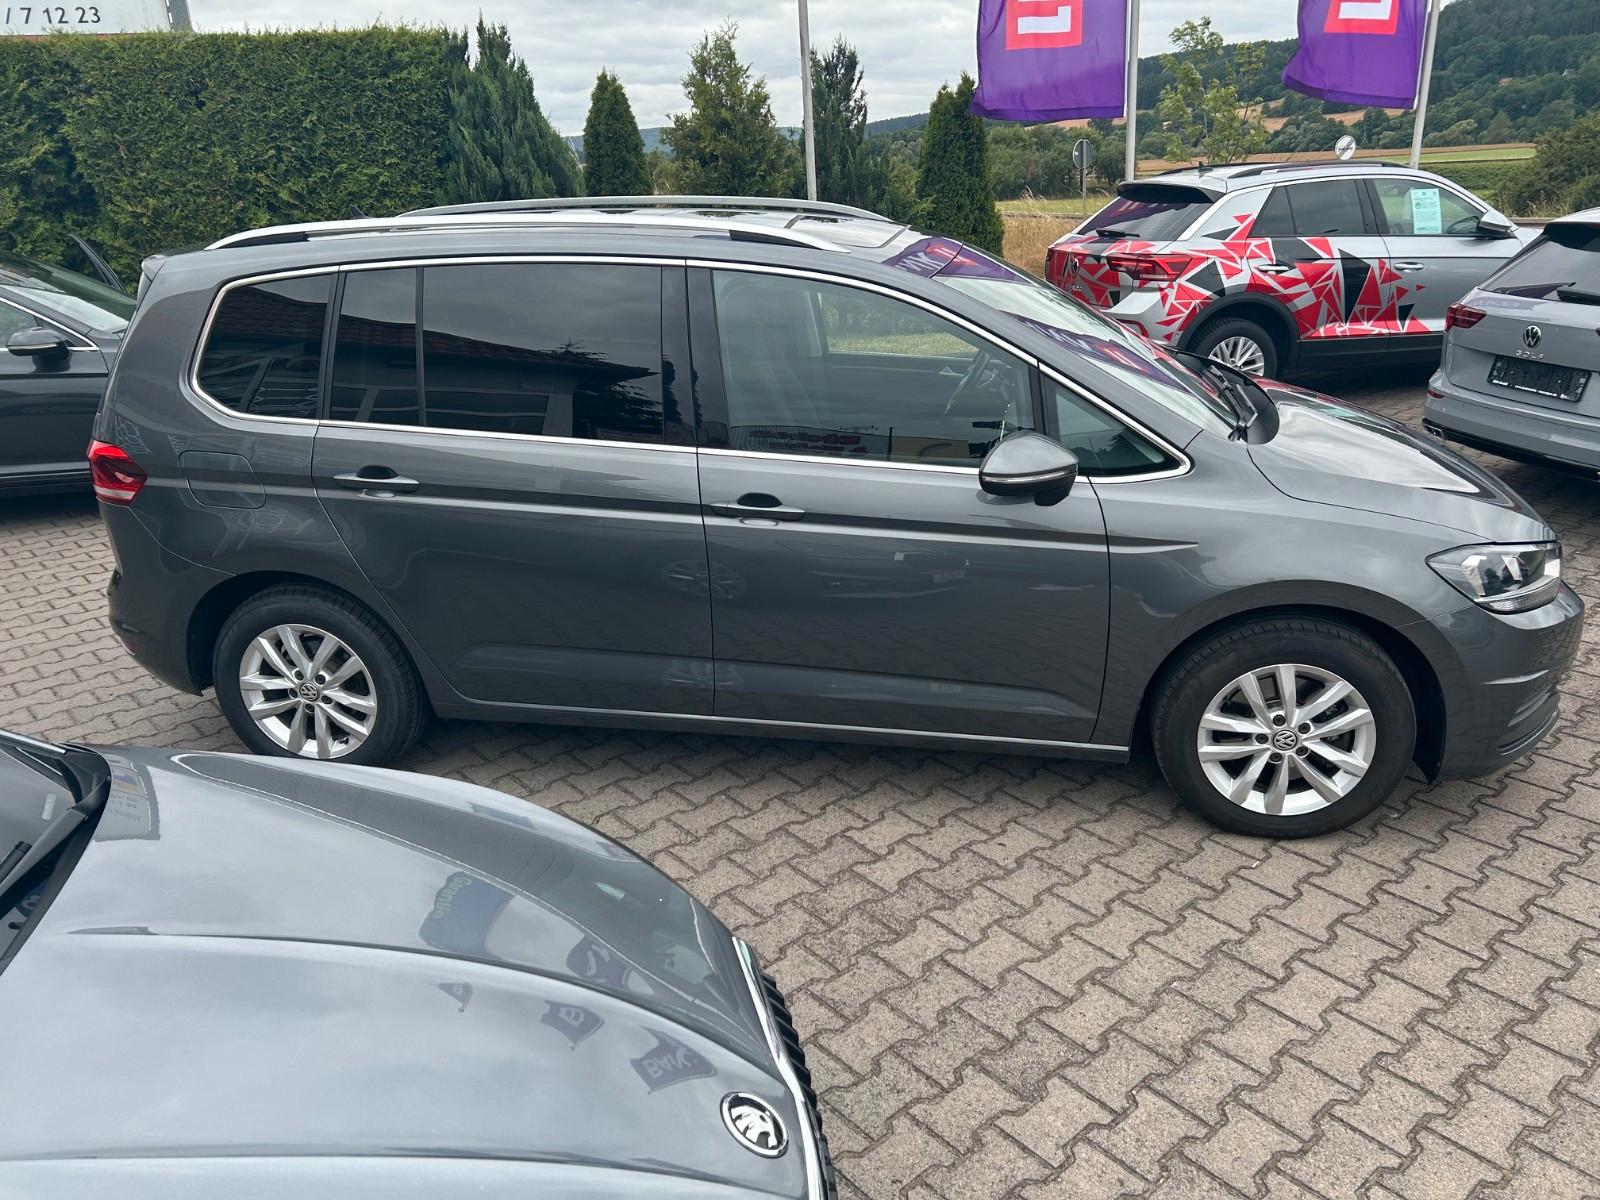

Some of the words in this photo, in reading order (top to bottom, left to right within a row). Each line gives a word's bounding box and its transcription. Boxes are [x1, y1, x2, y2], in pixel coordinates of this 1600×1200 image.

[20, 7, 32, 24] 7
[43, 7, 68, 24] 12
[75, 7, 100, 23] 23
